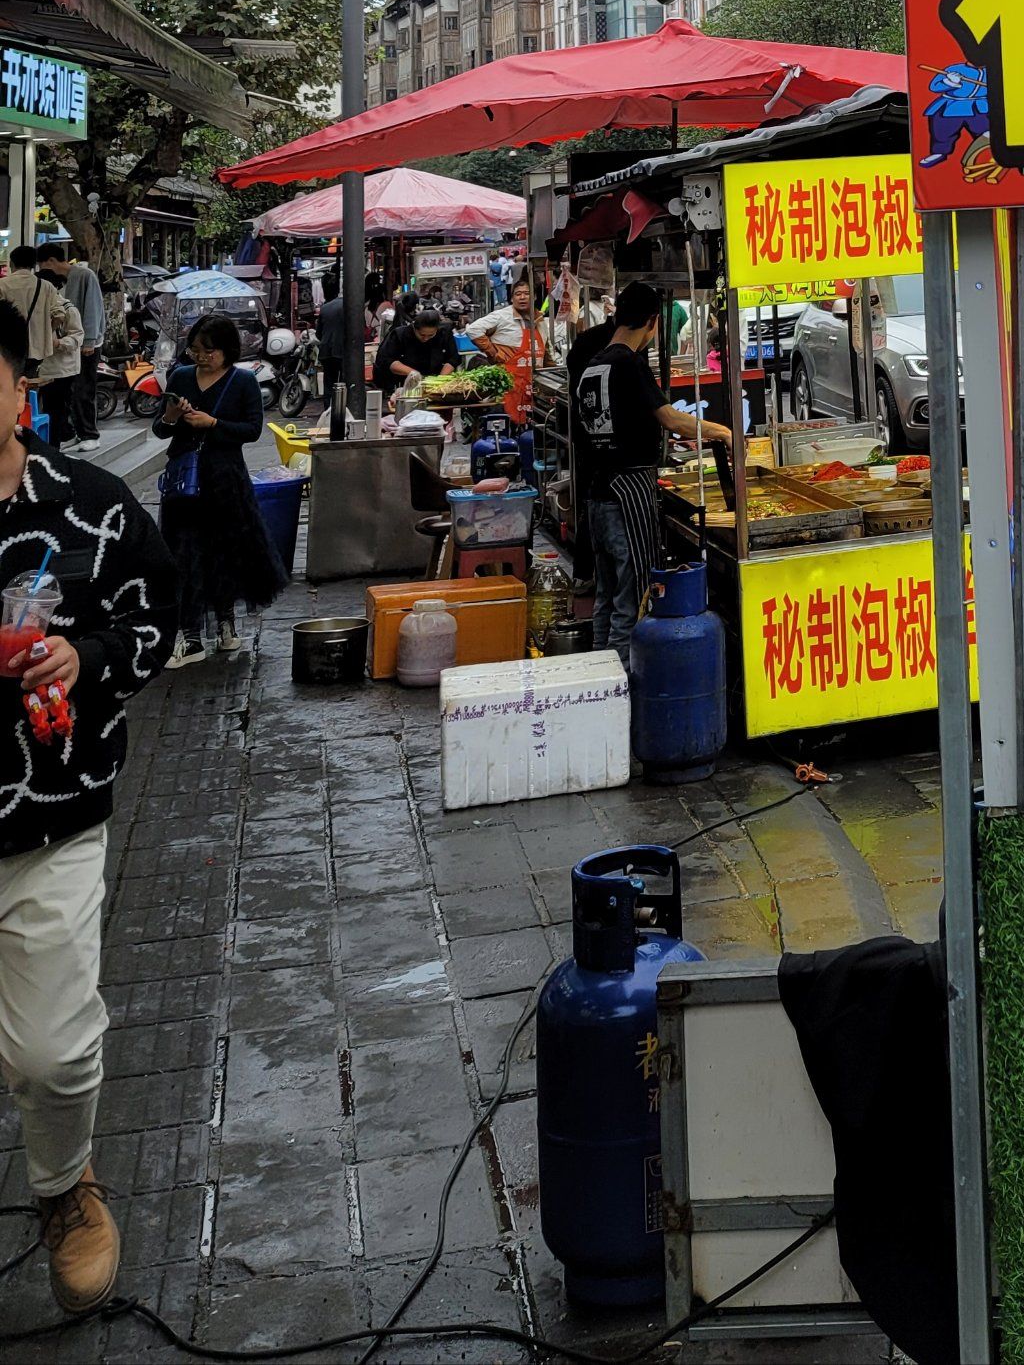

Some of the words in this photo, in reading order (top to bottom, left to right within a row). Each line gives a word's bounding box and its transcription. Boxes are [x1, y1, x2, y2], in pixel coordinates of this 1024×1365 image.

[1, 47, 86, 125] 书亦烧仙草
[744, 175, 923, 266] 秘制泡椒
[761, 576, 976, 700] 秘制泡椒
